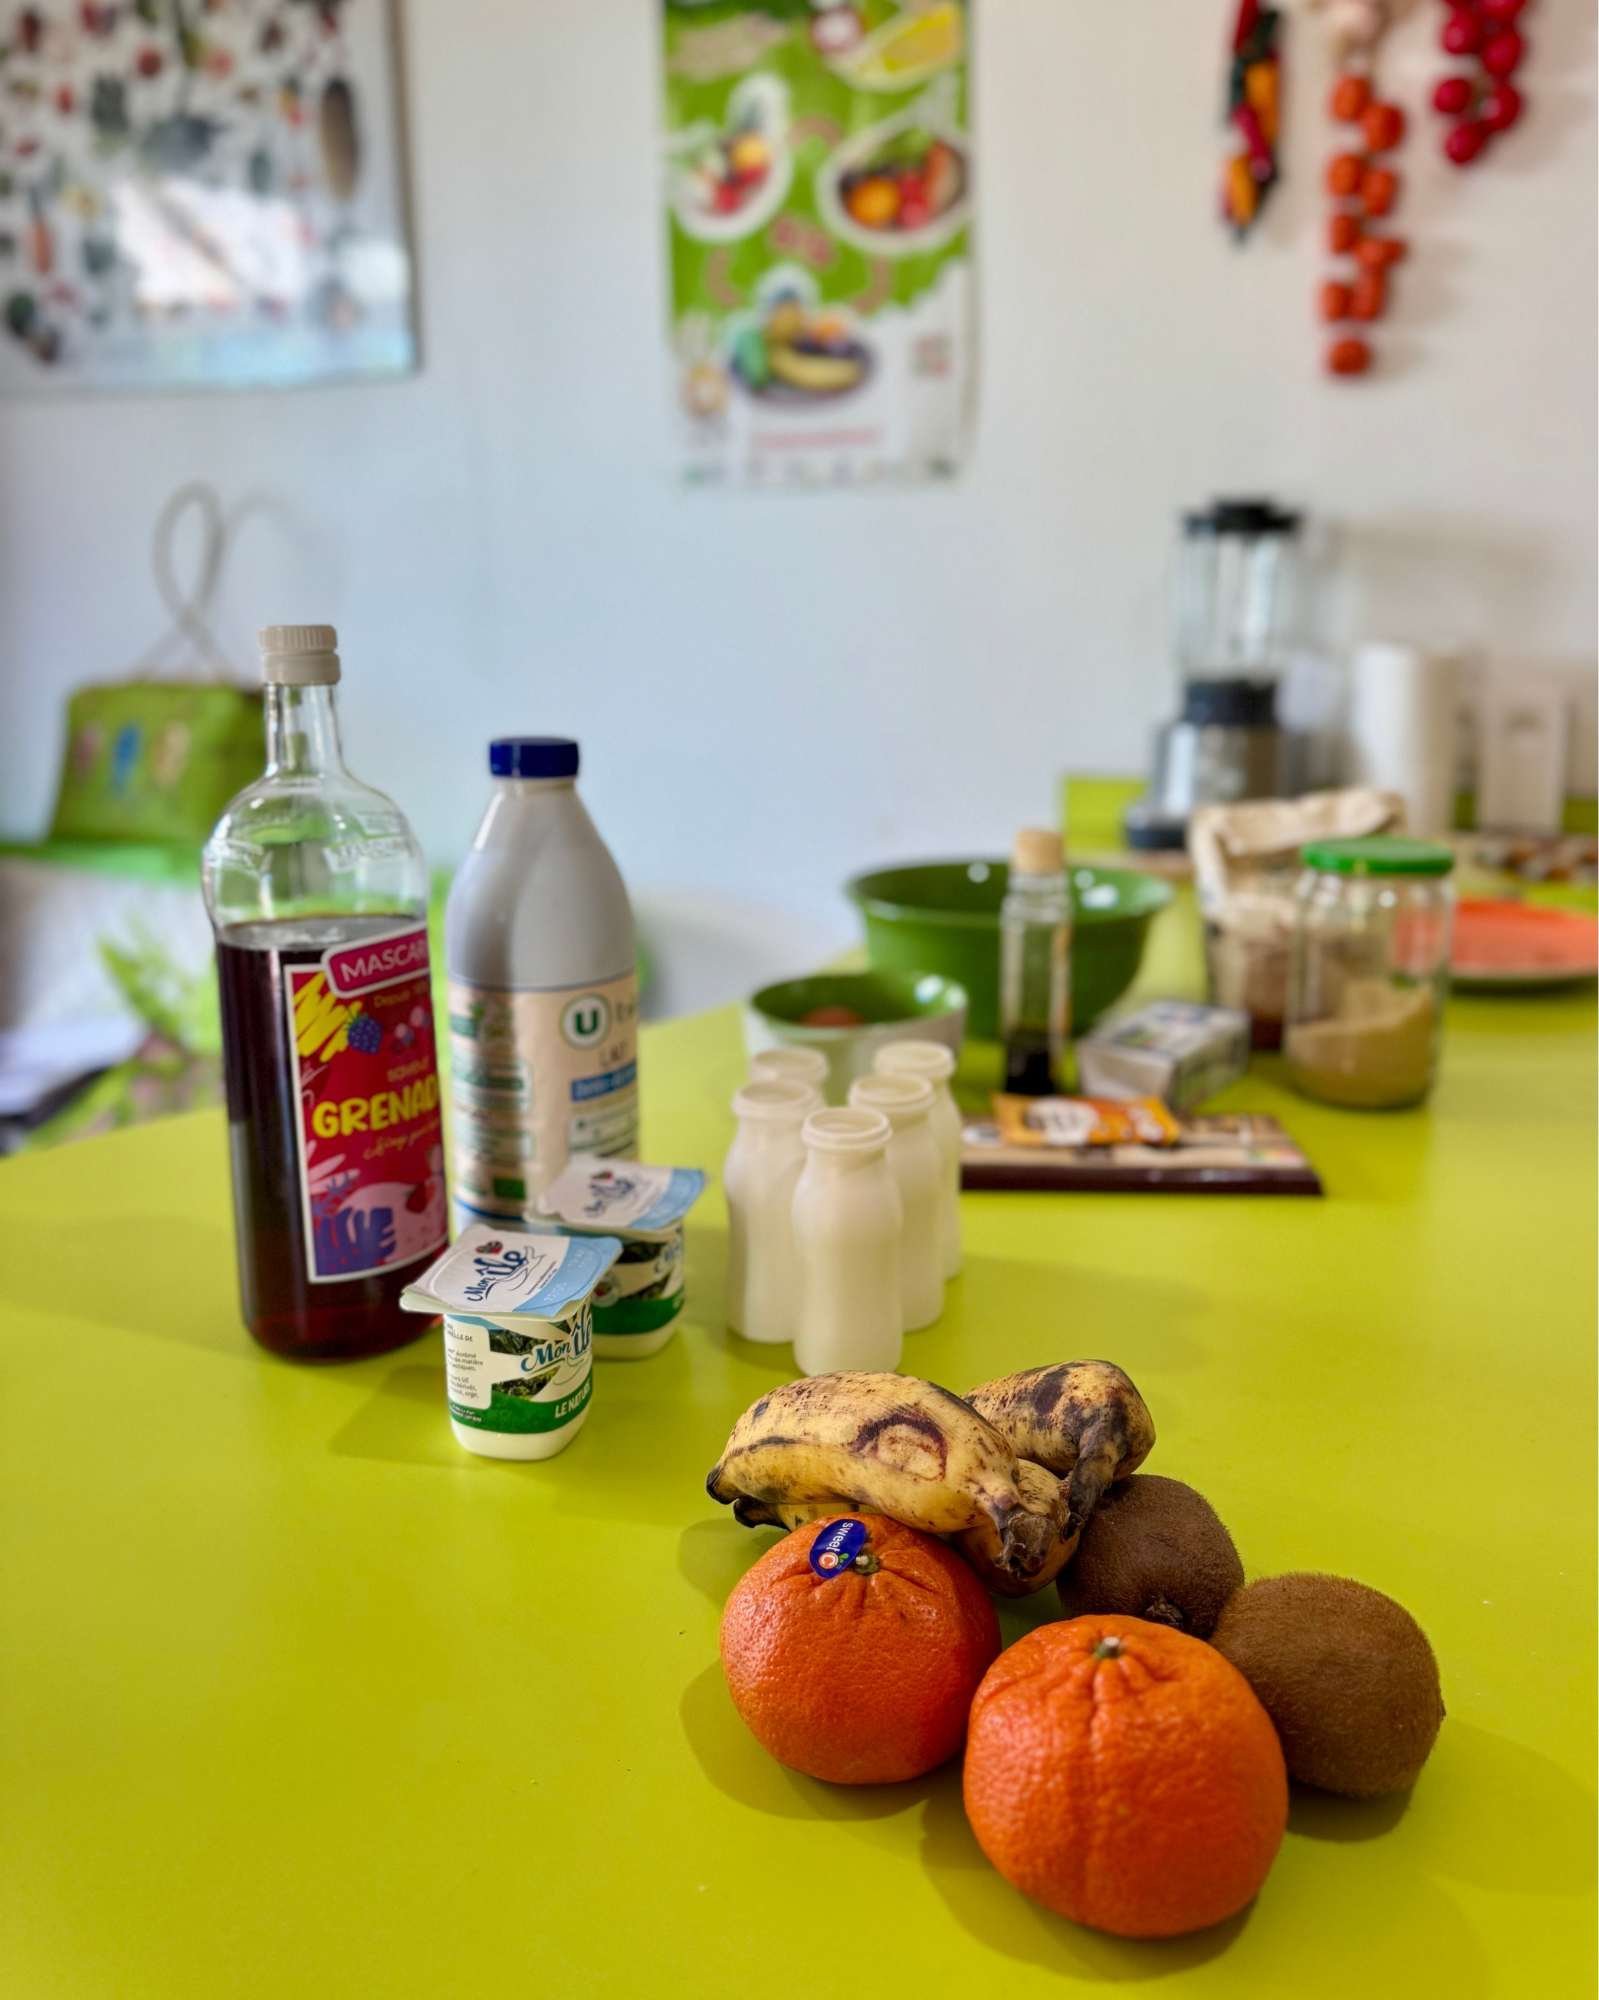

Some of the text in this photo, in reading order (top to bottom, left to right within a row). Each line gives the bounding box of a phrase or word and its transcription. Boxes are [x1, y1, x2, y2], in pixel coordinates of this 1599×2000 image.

[575, 1009, 599, 1036] U
[463, 1277, 497, 1302] Mon
[521, 1342, 571, 1372] Mon
